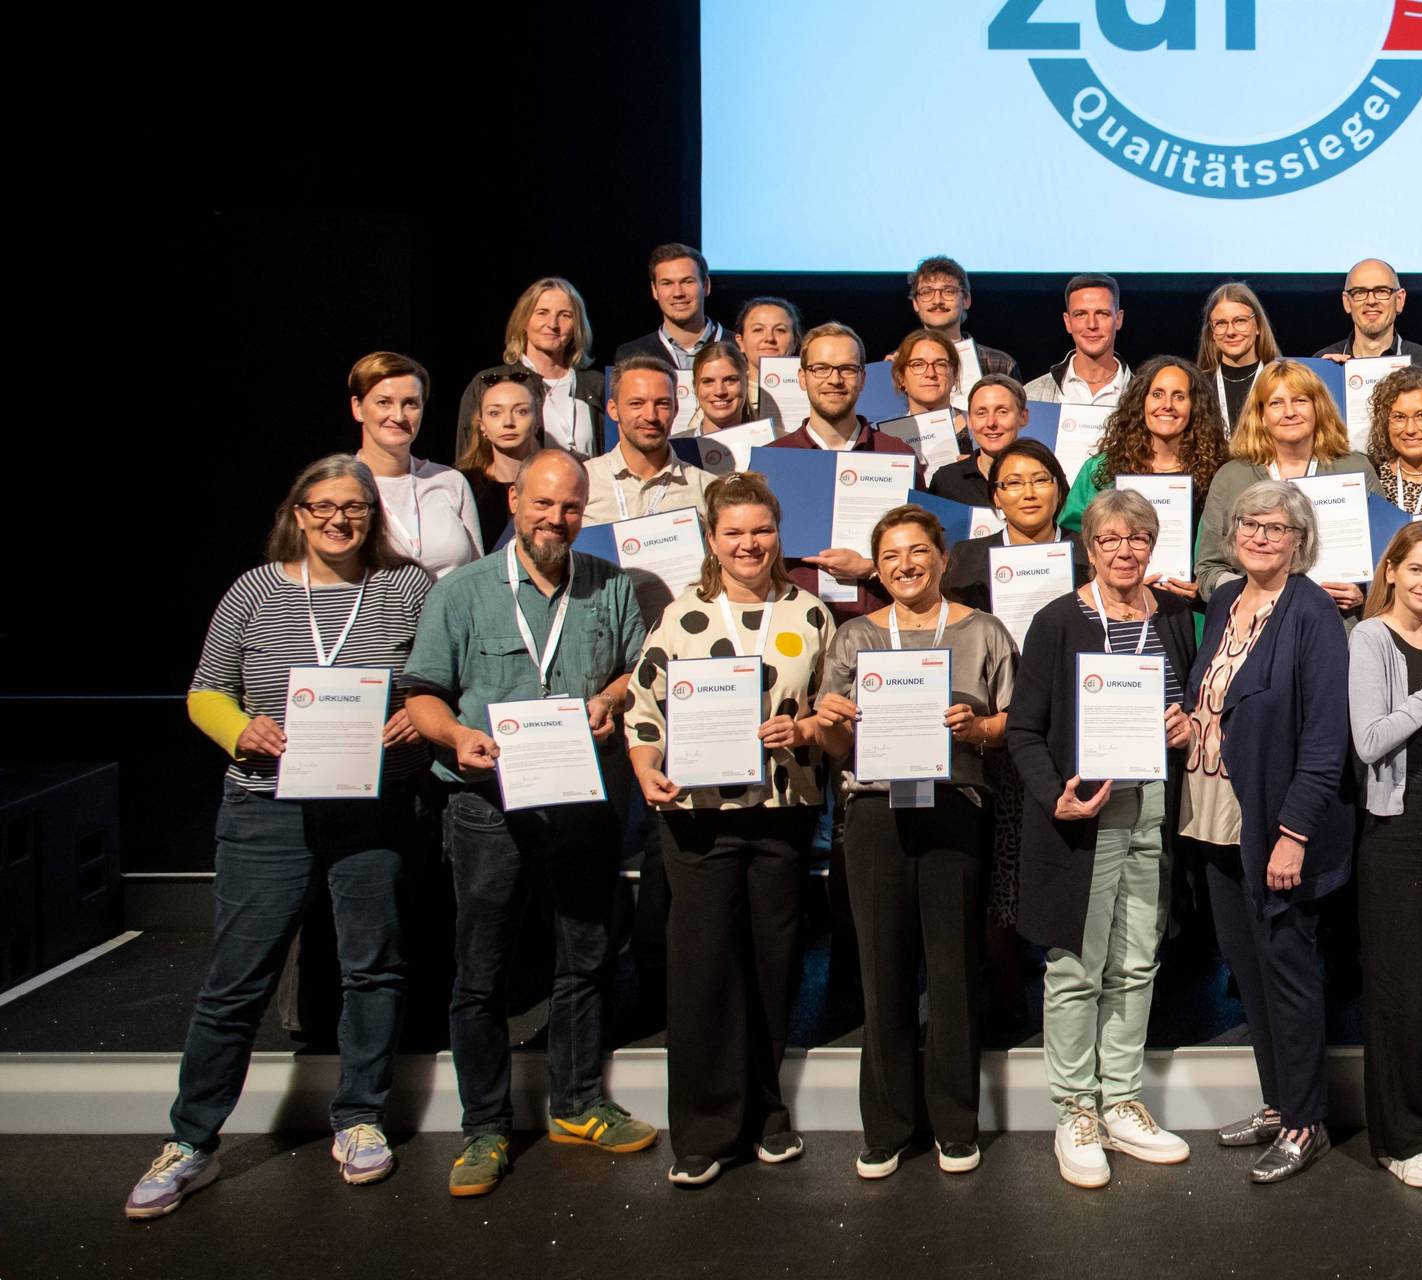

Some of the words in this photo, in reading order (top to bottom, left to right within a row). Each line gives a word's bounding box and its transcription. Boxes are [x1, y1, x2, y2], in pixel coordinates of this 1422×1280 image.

[1071, 75, 1401, 188] Qualitätssiegel
[905, 433, 936, 444] URKUNDE
[1313, 497, 1346, 506] URKUNDE
[643, 535, 679, 547] URKUNDE
[1016, 567, 1050, 576] URKUNDE
[886, 677, 925, 686] URKUNDE
[1106, 680, 1142, 688] URKUNDE
[697, 684, 736, 693] URKUNDE
[318, 695, 361, 703] URKUNDE
[523, 719, 564, 729] URKUNDE
